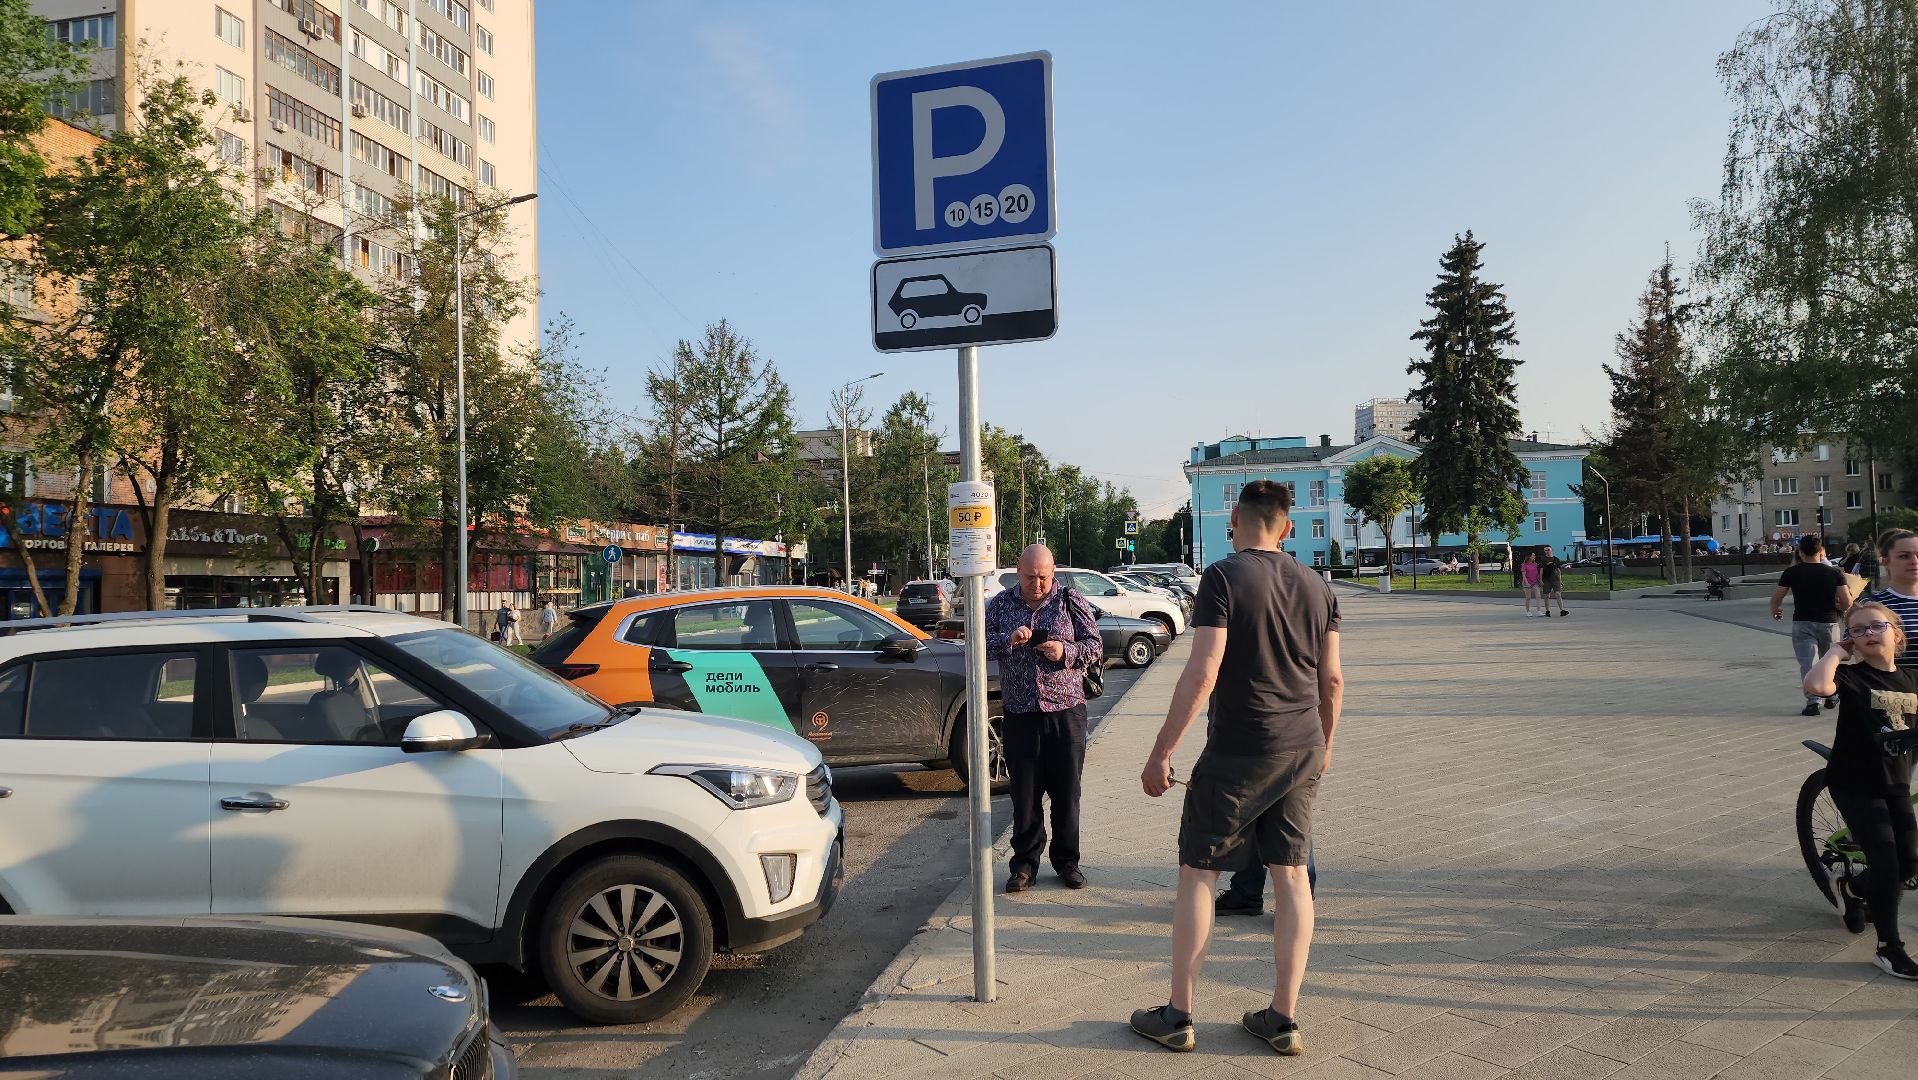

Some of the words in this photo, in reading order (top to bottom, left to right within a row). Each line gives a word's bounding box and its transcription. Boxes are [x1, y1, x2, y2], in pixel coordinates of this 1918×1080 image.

[912, 85, 1006, 230] P
[949, 208, 965, 222] 10
[974, 201, 994, 219] 15
[1004, 194, 1029, 214] 20
[958, 512, 971, 522] 50
[84, 541, 134, 552] ГАЛЕРЕЯ
[706, 672, 743, 682] дели
[705, 682, 760, 693] мобиль
